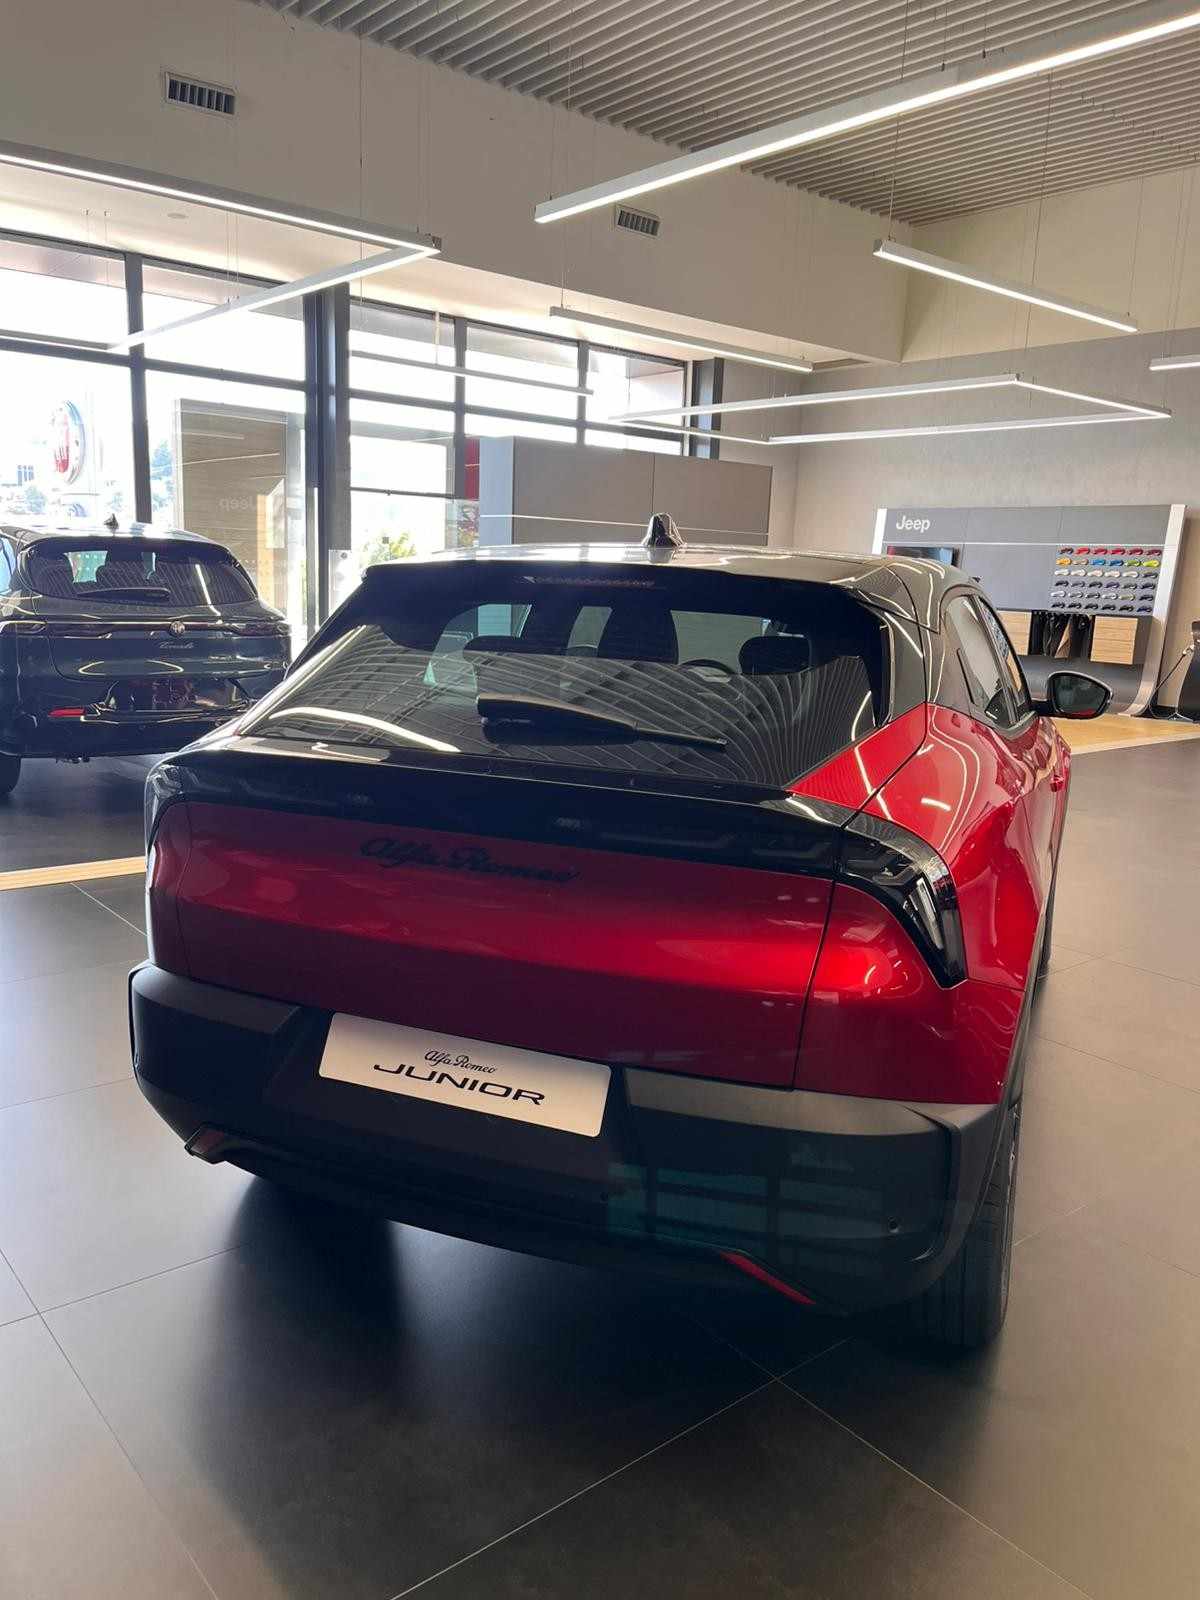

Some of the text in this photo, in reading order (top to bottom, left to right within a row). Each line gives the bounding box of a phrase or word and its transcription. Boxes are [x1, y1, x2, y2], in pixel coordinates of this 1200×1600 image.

[896, 515, 930, 533] Jeep
[361, 838, 580, 882] Alfa Romeo
[424, 1050, 498, 1074] Alfa Romeo
[373, 1063, 545, 1105] JUNIOR
